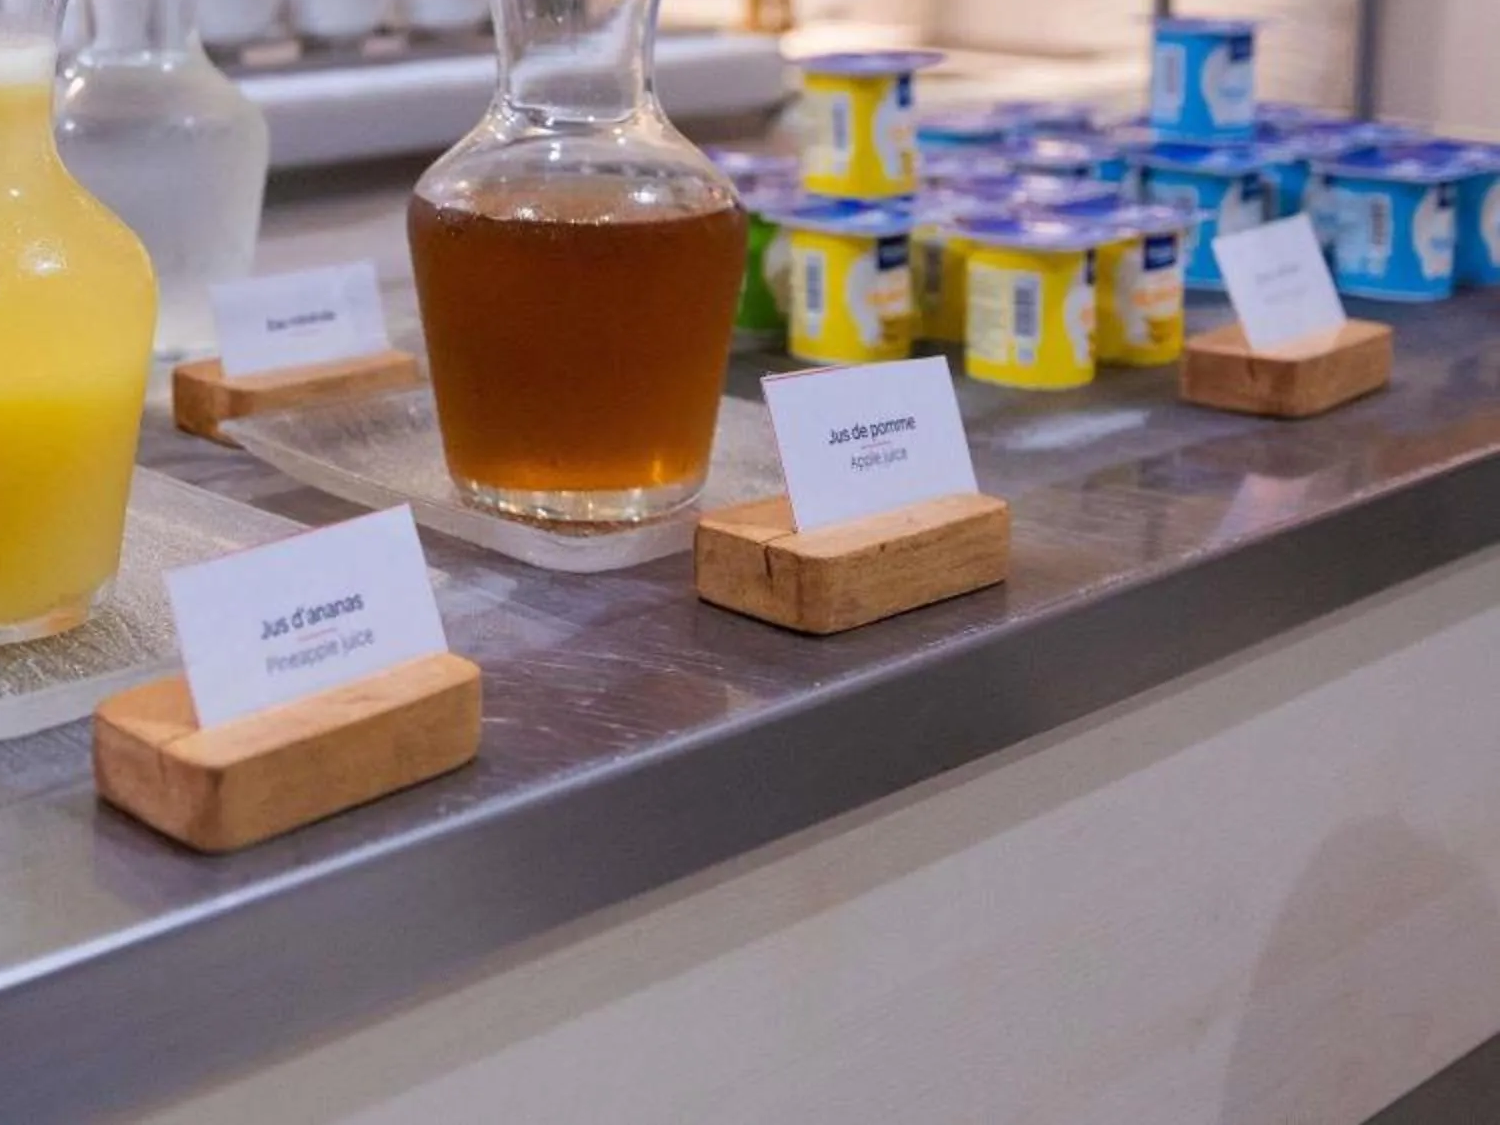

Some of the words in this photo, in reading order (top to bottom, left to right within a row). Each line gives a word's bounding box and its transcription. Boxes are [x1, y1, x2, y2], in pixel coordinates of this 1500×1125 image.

[828, 428, 850, 445] Jus
[851, 421, 868, 440] de
[869, 416, 916, 442] pomme
[260, 618, 289, 641] Jus
[265, 639, 338, 676] Pineapple
[340, 628, 375, 657] juice
